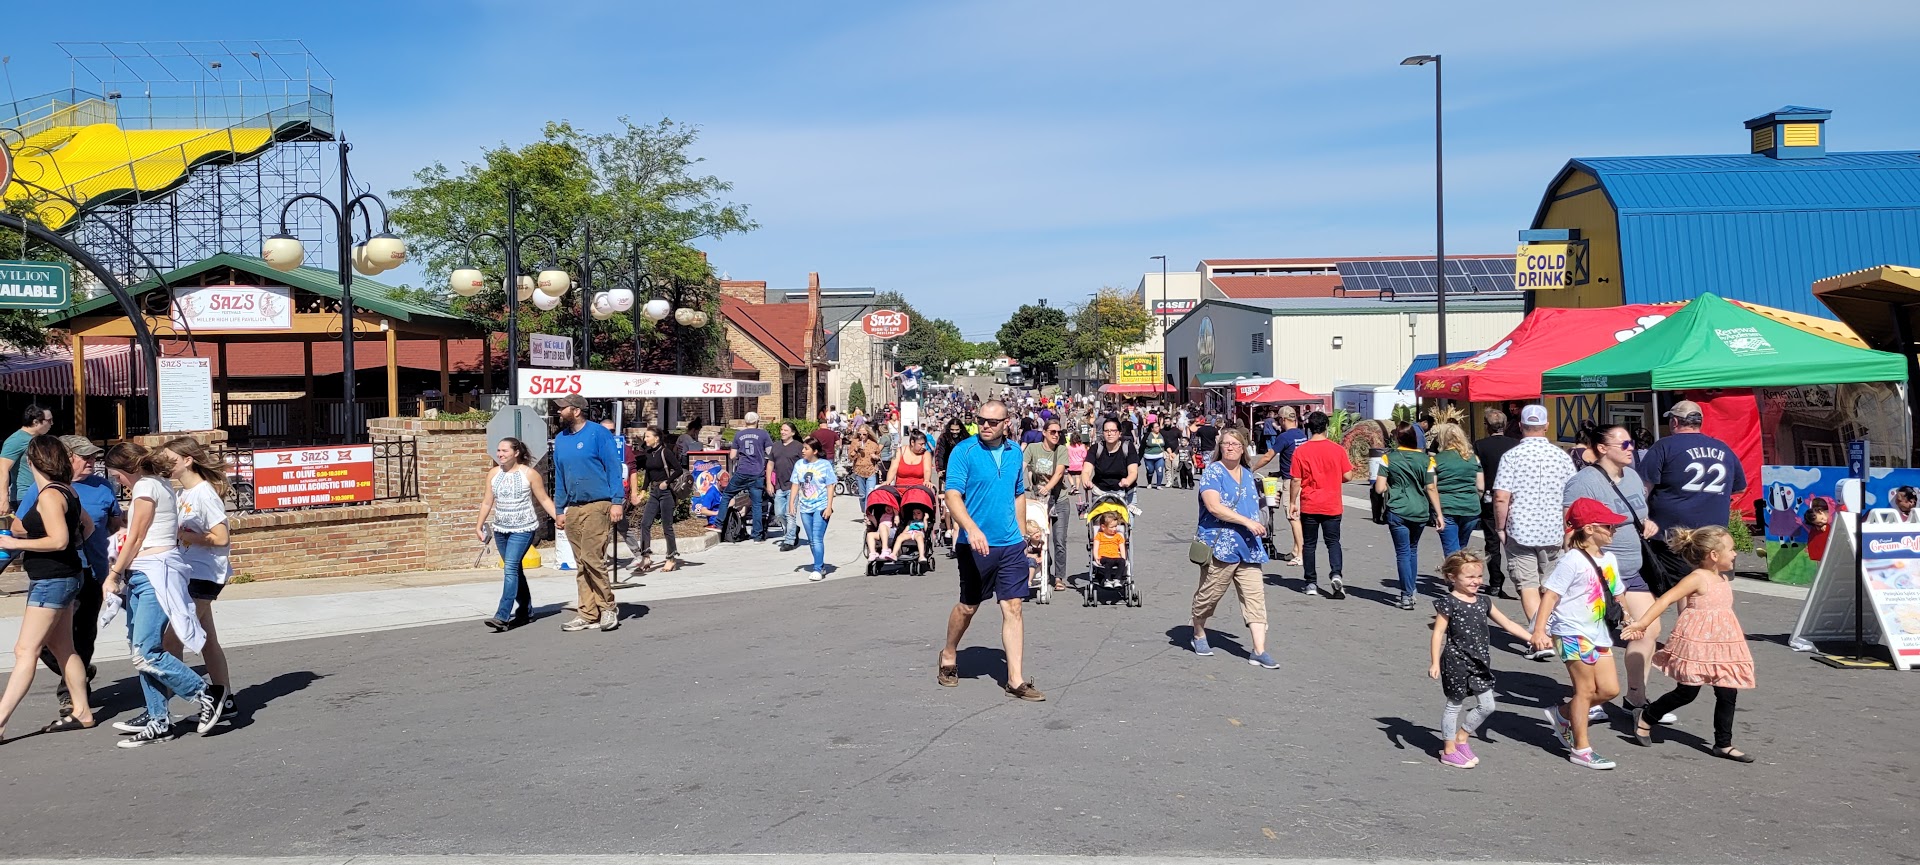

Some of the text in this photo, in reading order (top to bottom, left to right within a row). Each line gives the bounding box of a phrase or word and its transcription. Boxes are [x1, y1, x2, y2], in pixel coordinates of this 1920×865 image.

[1527, 255, 1565, 270] COLD
[0, 270, 50, 281] VILION
[1518, 270, 1573, 287] DRINKS
[0, 284, 58, 298] AILABLE
[209, 293, 255, 310] SAZ'S
[1157, 301, 1185, 309] CASE
[870, 314, 902, 327] SAZ'S
[1153, 316, 1179, 327] Colis
[528, 375, 582, 395] SAZ'S
[702, 382, 732, 394] SAZ'S
[1762, 387, 1802, 400] Renewal
[744, 440, 755, 455] 5
[1685, 446, 1725, 461] YELICH
[301, 451, 330, 462] SAZ'S
[282, 471, 295, 480] MT.
[296, 469, 316, 479] OLIVE
[1681, 462, 1727, 493] 22
[258, 484, 288, 495] RANDOM
[288, 482, 307, 493] MAXX
[308, 480, 340, 491] ACOUSTIC
[341, 479, 356, 488] TRIO
[277, 496, 292, 506] THE
[292, 495, 310, 505] NOW
[311, 493, 331, 503] BAND
[1615, 496, 1645, 512] YTI
[1871, 540, 1900, 552] Cream
